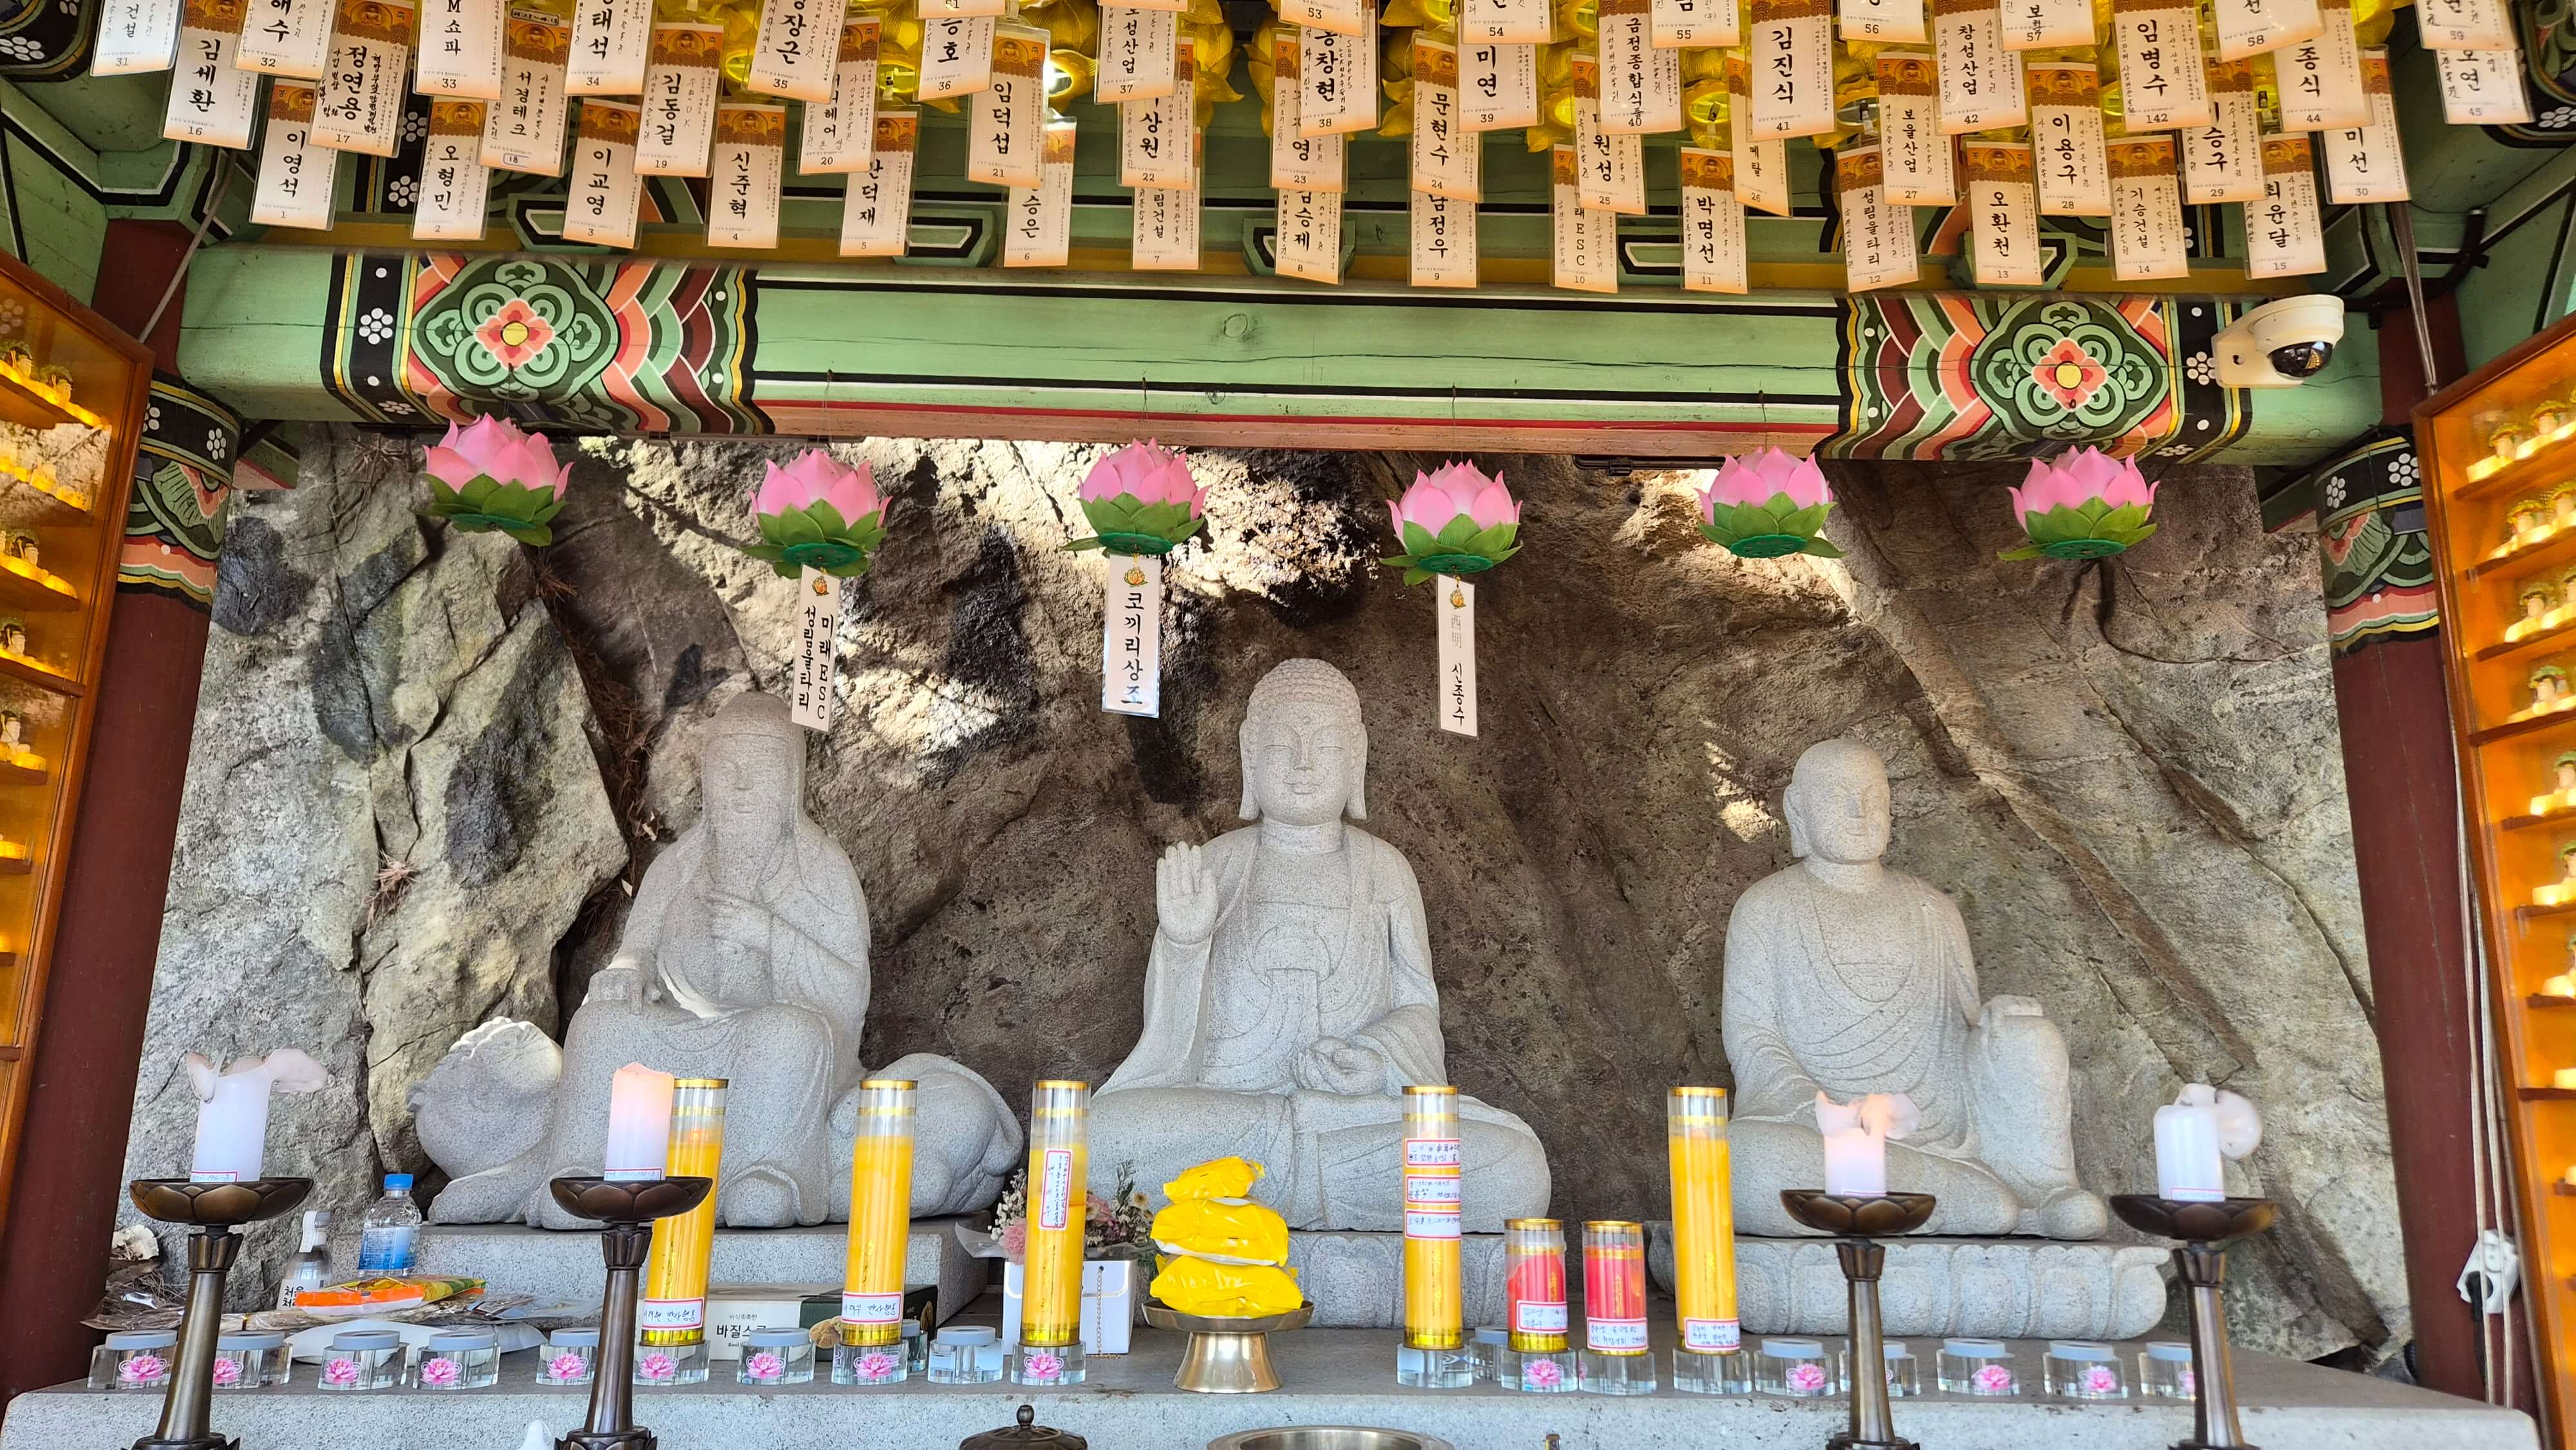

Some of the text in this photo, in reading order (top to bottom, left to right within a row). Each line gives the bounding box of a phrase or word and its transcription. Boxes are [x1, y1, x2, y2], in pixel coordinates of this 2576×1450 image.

[1308, 8, 1322, 19] 53
[1489, 26, 1504, 37] 54
[1865, 24, 1879, 34] 56
[1676, 30, 1691, 39] 55
[2027, 32, 2042, 42] 57
[2248, 35, 2264, 47] 58
[116, 58, 128, 66] 31
[260, 57, 276, 68] 32
[1958, 24, 1979, 96] 창성산업
[2137, 19, 2168, 97] 임병수
[1772, 26, 1794, 105] 김진식
[2295, 39, 2321, 98] 종식
[189, 39, 221, 112] 김세환
[1476, 45, 1497, 97] 미연
[337, 45, 367, 120] 정연용
[442, 78, 457, 89] 33
[585, 77, 600, 86] 34
[773, 78, 788, 89] 35
[938, 80, 951, 91] 36
[1120, 84, 1133, 94] 37
[990, 81, 1012, 155] 임덕섭
[1319, 118, 1332, 127] 38
[1481, 113, 1494, 123] 39
[1628, 118, 1642, 127] 40
[1964, 114, 1979, 124] 42
[2146, 114, 2168, 124] 142
[2306, 113, 2321, 123] 44
[187, 127, 203, 136] 16
[1139, 98, 1162, 158] 상원
[1430, 92, 1450, 167] 문현수
[1777, 122, 1790, 131] 41
[336, 134, 350, 144] 17
[2052, 113, 2078, 185] 이용구
[278, 130, 306, 199] 이영석
[654, 160, 668, 169] 19
[821, 156, 833, 165] 20
[434, 144, 460, 212] 오형민
[992, 168, 1005, 178] 21
[1142, 173, 1155, 182] 22
[1294, 175, 1306, 184] 23
[1431, 180, 1443, 189] 24
[728, 151, 751, 220] 신준혁
[1905, 191, 1917, 199] 27
[2210, 189, 2224, 198] 29
[2355, 188, 2369, 196] 30
[1598, 196, 1611, 205] 25
[1751, 193, 1761, 202] 26
[2061, 200, 2074, 209] 28
[1019, 188, 1041, 239] 승은
[1153, 188, 1164, 238] 림건설
[2130, 187, 2149, 249] 기승건설
[1428, 194, 1449, 259] 남정우
[1696, 195, 1716, 263] 박명선
[587, 228, 594, 236] 3
[732, 232, 739, 241] 4
[1298, 264, 1303, 272] 8
[2273, 262, 2287, 270] 15
[1574, 275, 1585, 284] 10
[1869, 275, 1881, 284] 12
[1997, 270, 2009, 279] 13
[1701, 276, 1712, 285] 11
[1121, 592, 1144, 704] 코끼리상조
[817, 614, 834, 720] 미래ESC
[283, 1298, 296, 1308] 처
[717, 1324, 766, 1339] 바질스
